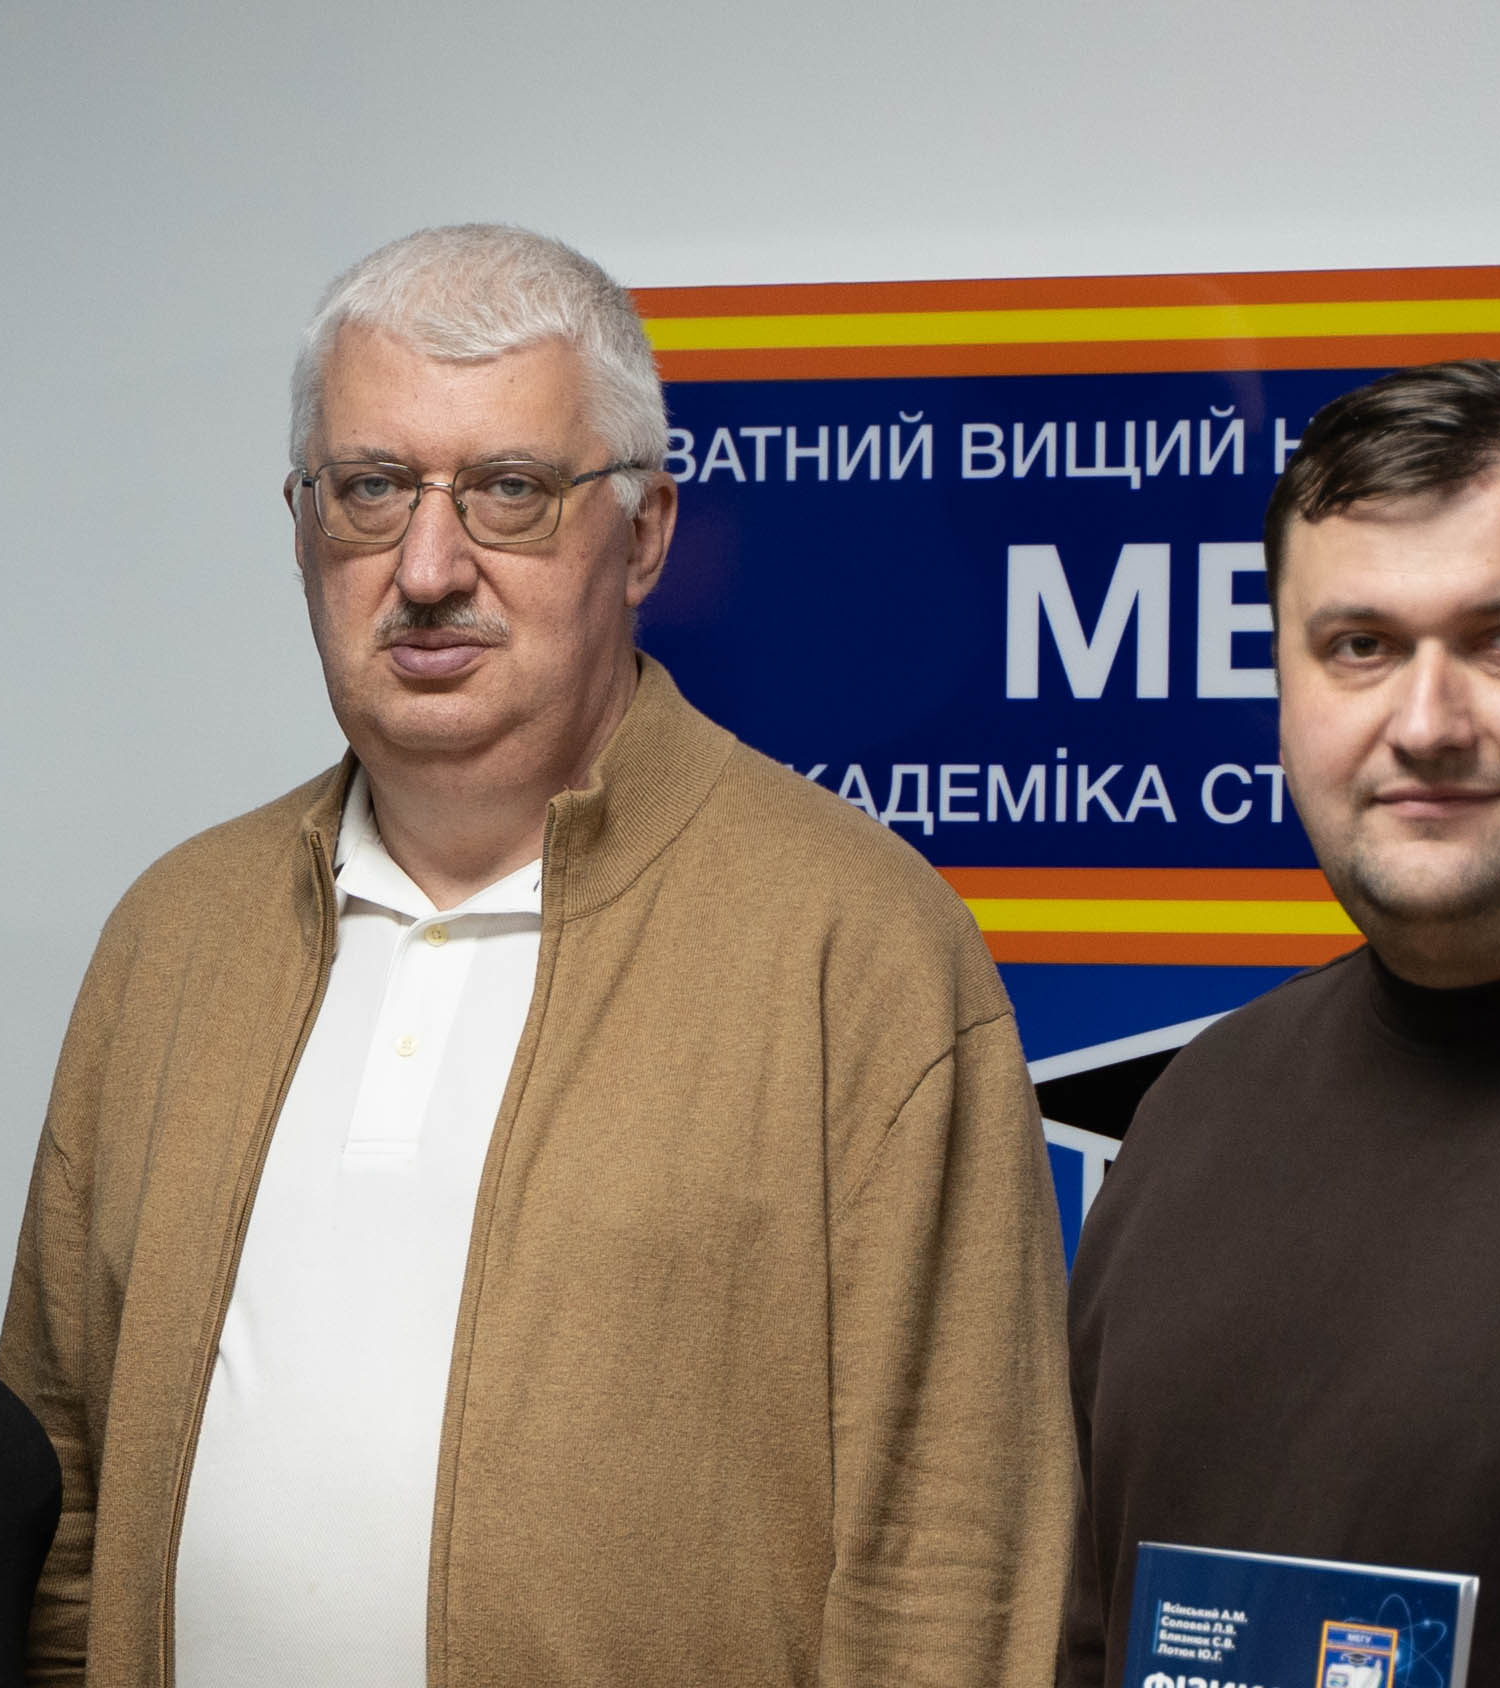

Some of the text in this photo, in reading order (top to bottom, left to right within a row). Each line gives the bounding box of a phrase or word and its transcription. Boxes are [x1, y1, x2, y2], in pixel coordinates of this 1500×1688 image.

[664, 411, 933, 483] ВАТНИЙ
[962, 405, 1245, 490] ВИЩИЙ
[1006, 542, 1280, 699] МЕ
